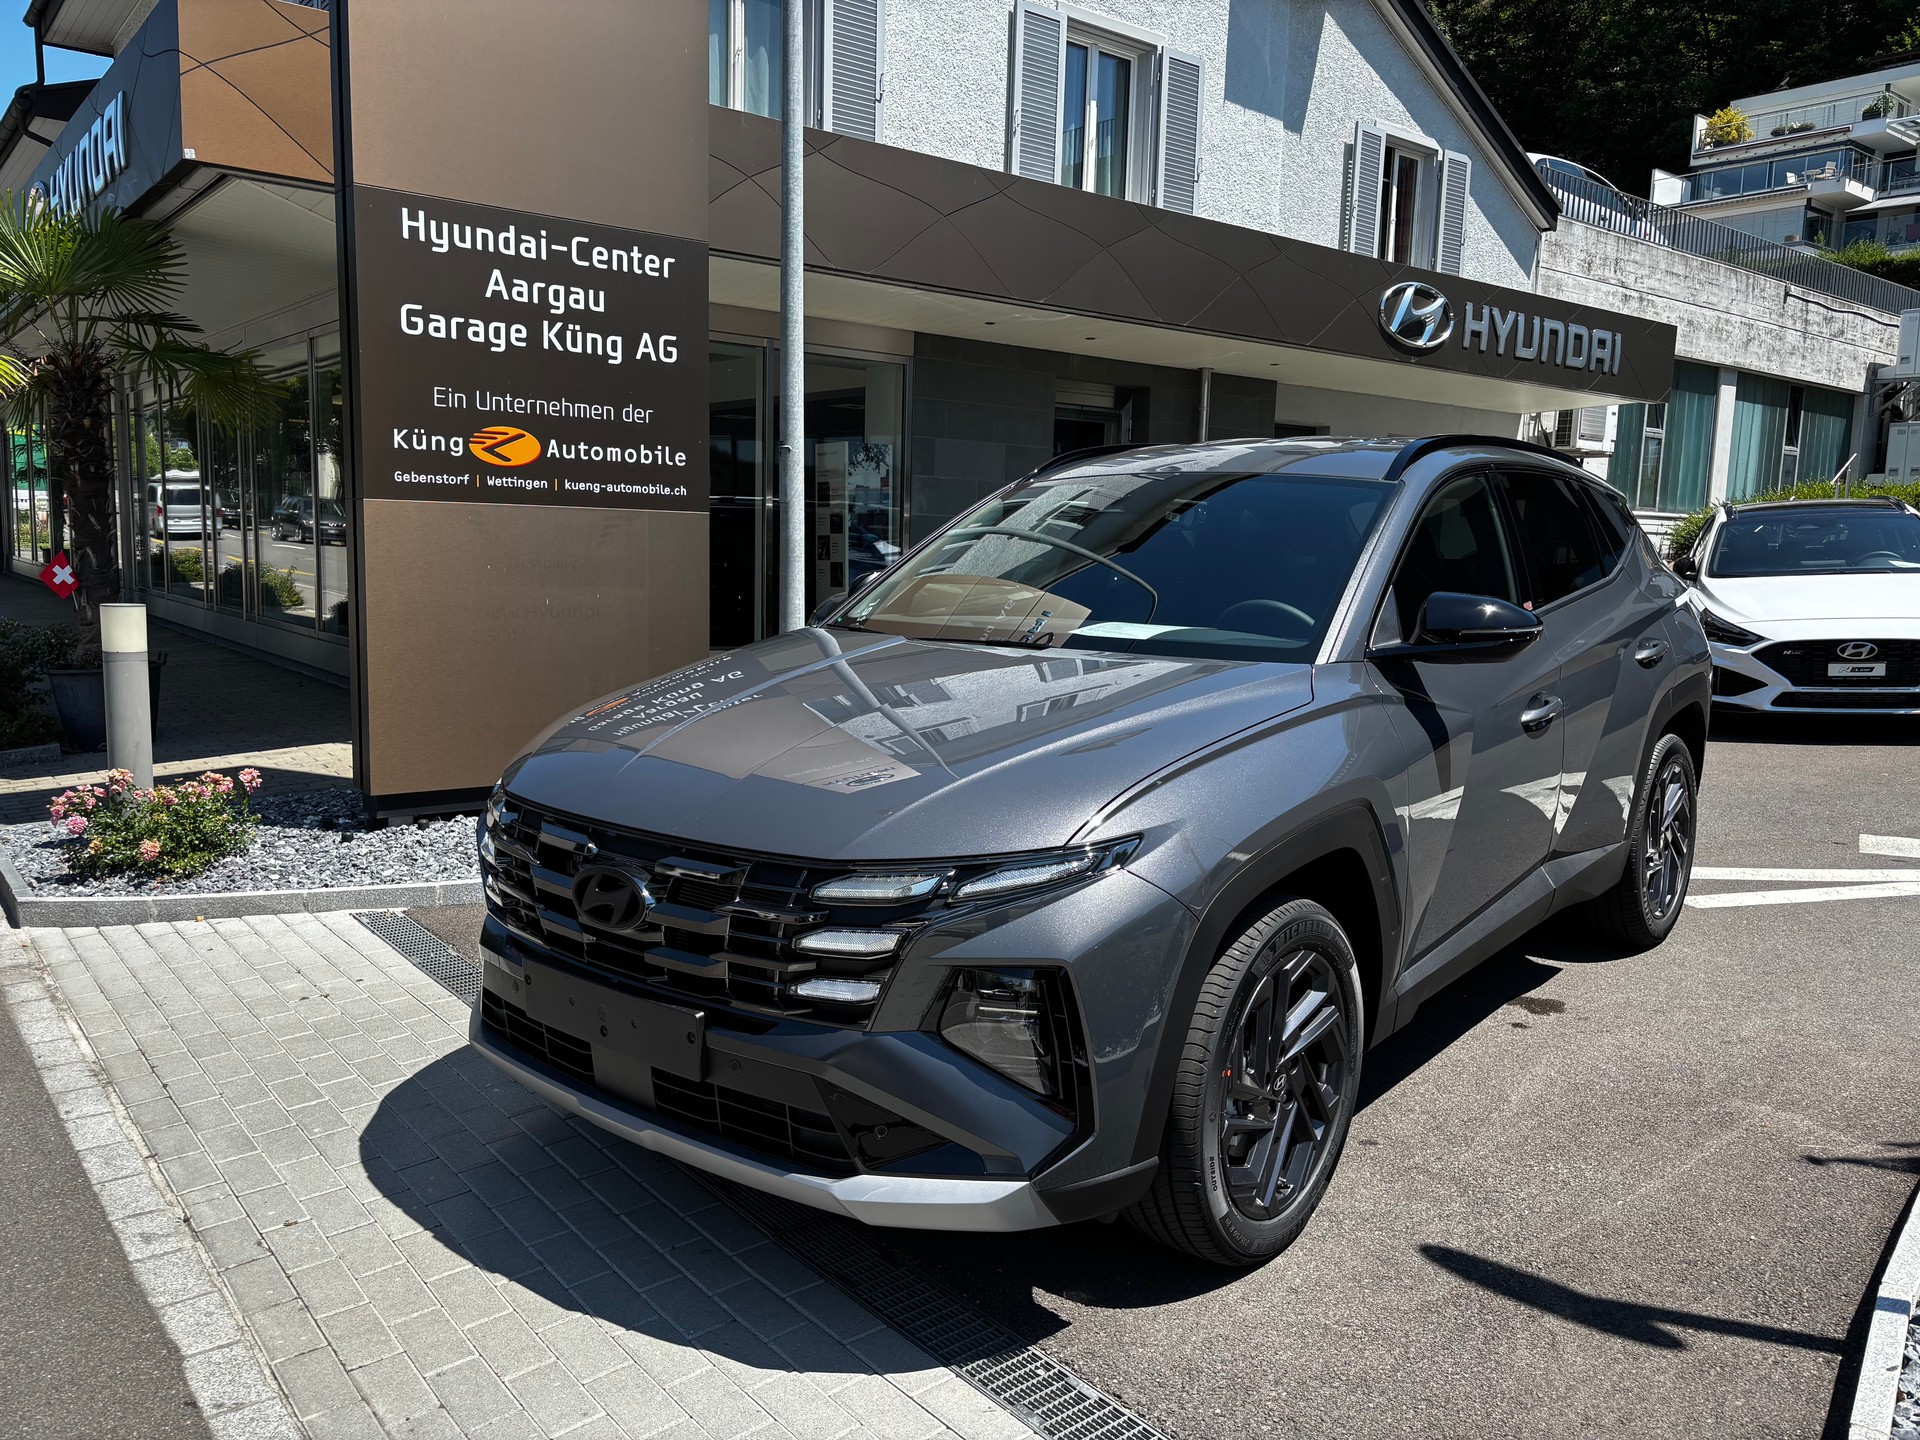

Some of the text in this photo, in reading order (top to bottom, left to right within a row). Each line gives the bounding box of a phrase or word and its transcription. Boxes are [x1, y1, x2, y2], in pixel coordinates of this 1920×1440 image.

[50, 90, 127, 228] HYUNDAI
[401, 206, 676, 279] Hyundai-Center
[484, 268, 605, 315] Aargau
[400, 303, 678, 365] Garage Küng AG
[1461, 301, 1623, 377] HYUNDAI
[433, 386, 654, 424] Ein Unternehmen der
[393, 428, 687, 467] Küng Automobile
[394, 470, 687, 496] Gebenstorf Wettingen kueng-automobile.ch
[1209, 1156, 1218, 1192] OUTSIDE
